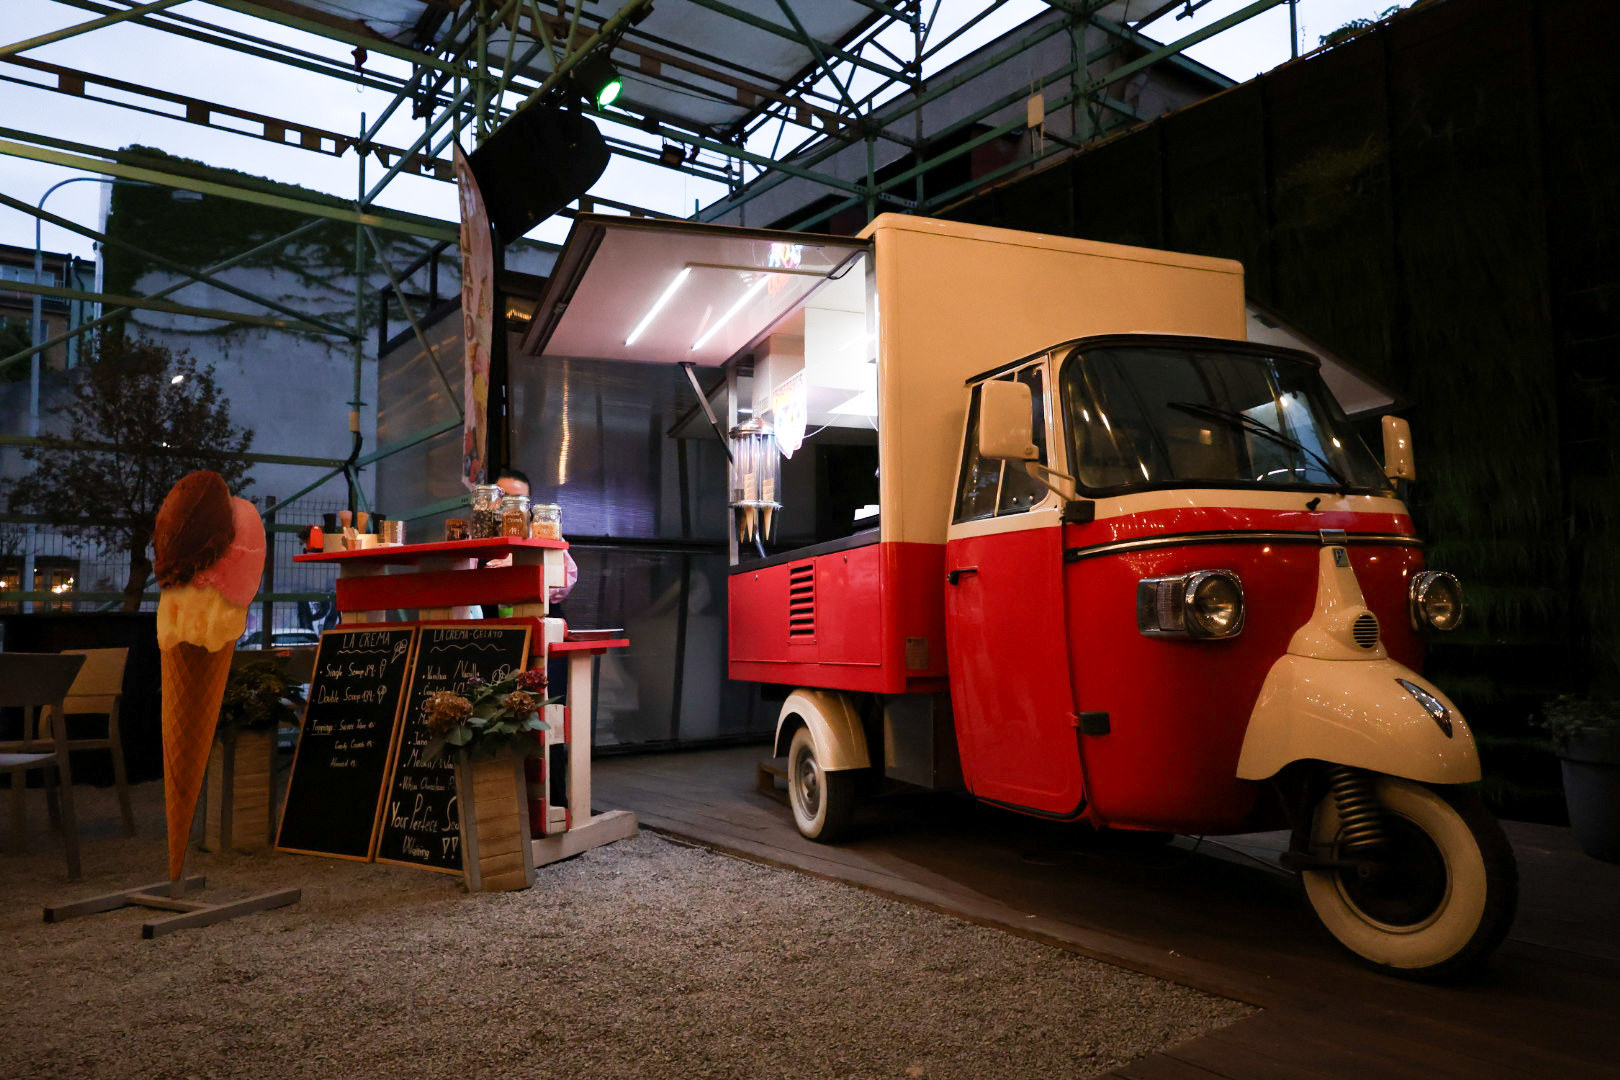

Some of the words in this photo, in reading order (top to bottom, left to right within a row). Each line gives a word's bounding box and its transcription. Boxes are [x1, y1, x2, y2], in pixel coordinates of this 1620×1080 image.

[343, 633, 355, 648] LA
[358, 631, 390, 648] CREMA
[433, 629, 443, 642] LA
[390, 801, 410, 830] Your
[410, 792, 438, 833] Perfect
